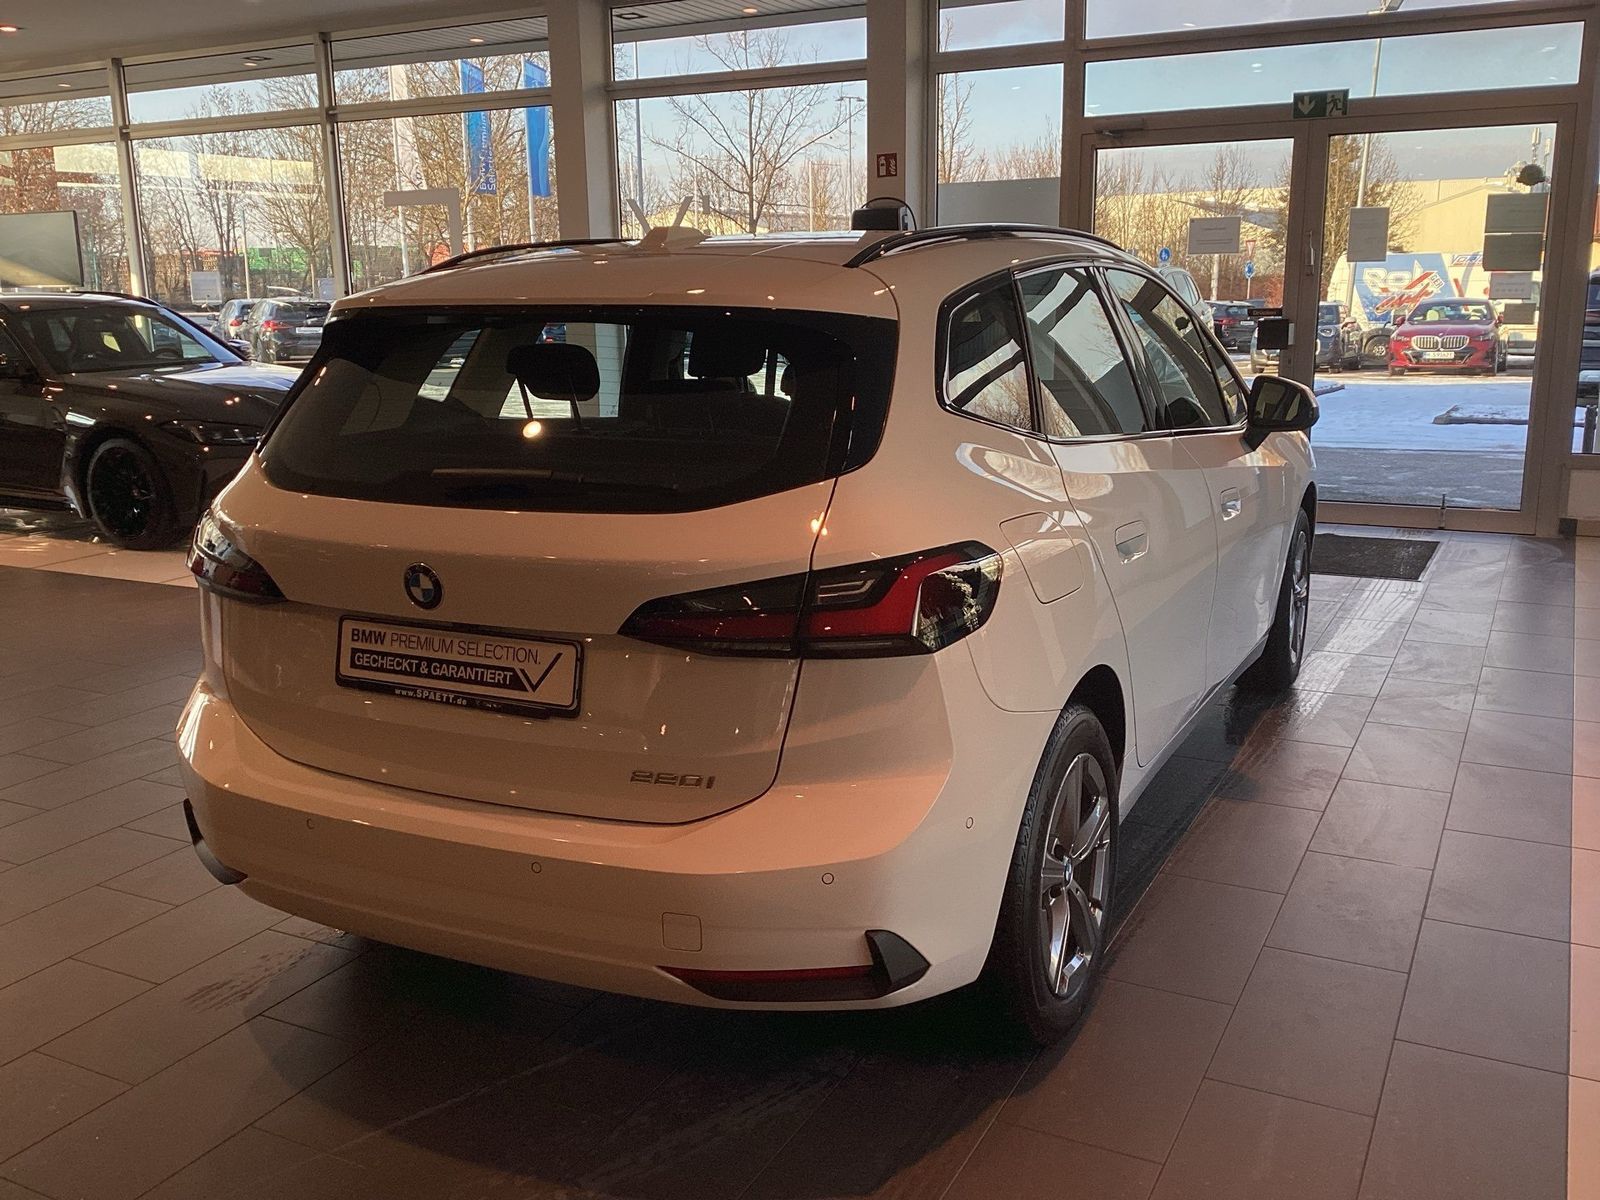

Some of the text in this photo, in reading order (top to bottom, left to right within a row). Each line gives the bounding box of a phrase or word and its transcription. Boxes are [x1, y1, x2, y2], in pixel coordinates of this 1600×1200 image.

[351, 628, 542, 665] BMW PREMIUM SELECTION.
[354, 653, 513, 685] GECHECKT & GARANTIERT
[395, 687, 467, 705] www.SPAETT.de
